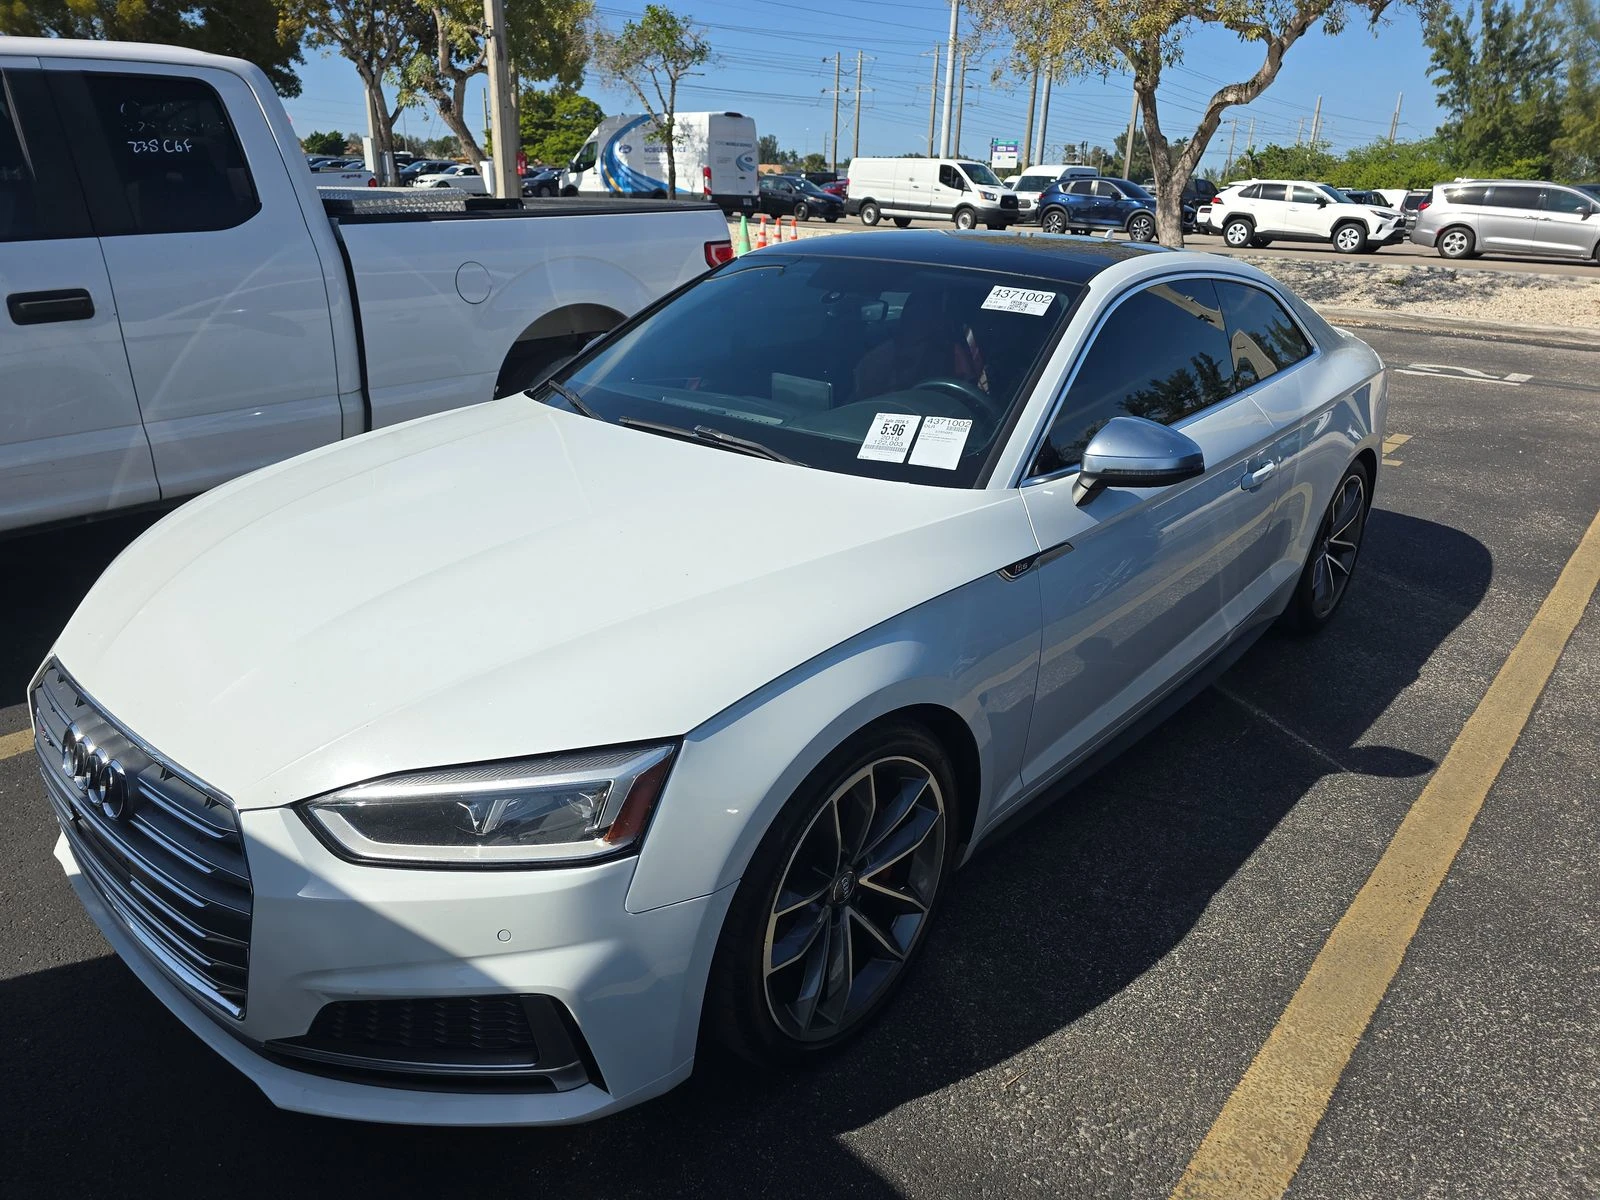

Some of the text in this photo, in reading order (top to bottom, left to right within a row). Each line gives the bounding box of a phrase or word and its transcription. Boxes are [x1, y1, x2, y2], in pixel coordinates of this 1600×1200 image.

[993, 289, 1053, 304] 4371002
[880, 423, 906, 436] 5:96
[927, 418, 972, 428] 4371002
